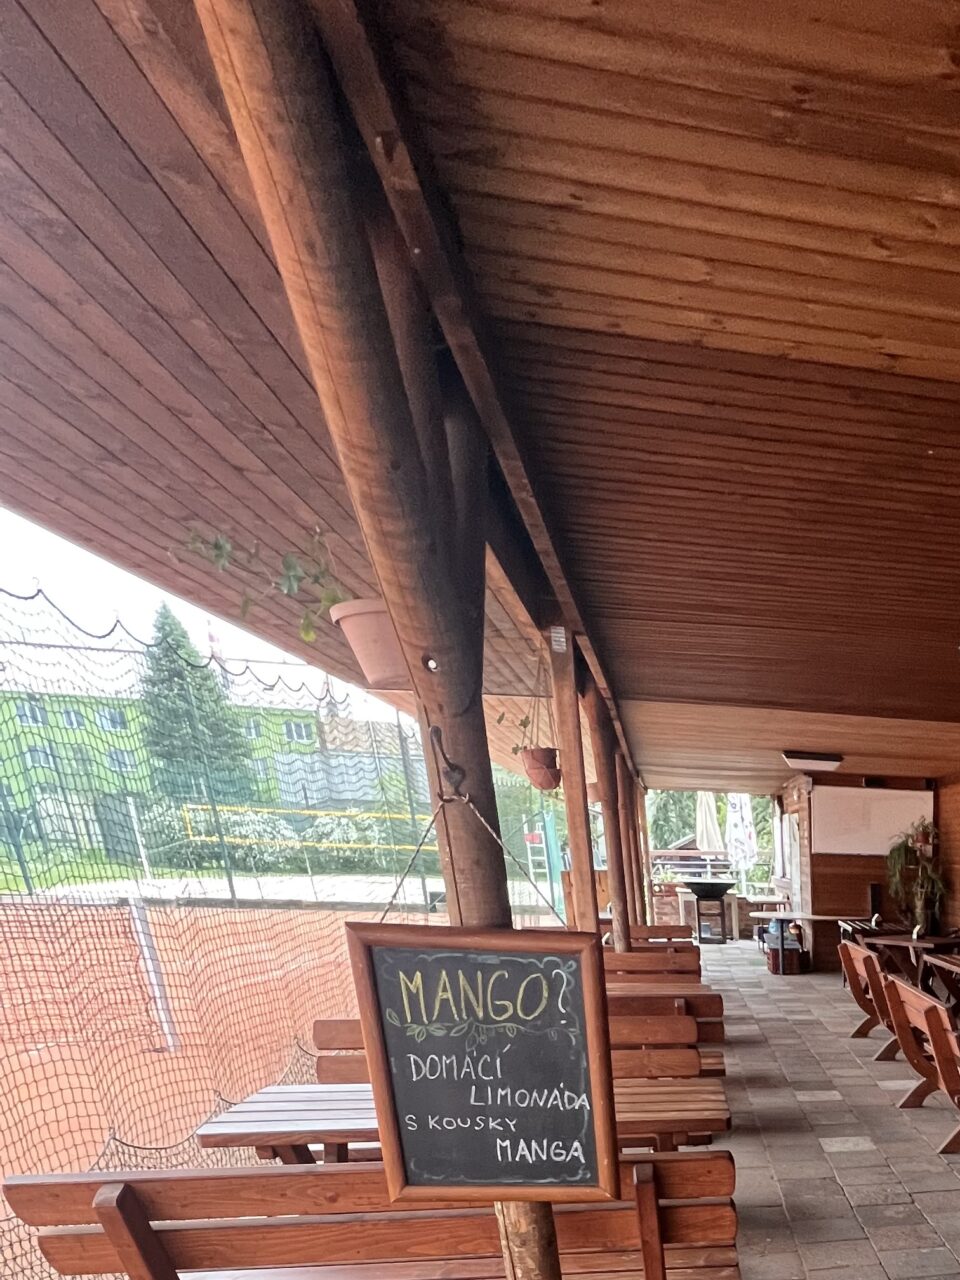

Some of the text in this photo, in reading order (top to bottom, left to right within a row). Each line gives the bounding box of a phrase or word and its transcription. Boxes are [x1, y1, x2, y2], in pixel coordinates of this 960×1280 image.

[399, 969, 568, 1024] MANGO?
[407, 1043, 511, 1081] DOMÁCÍ
[470, 1082, 590, 1111] LIMONÁDA
[405, 1114, 518, 1133] S KOUSKY
[496, 1138, 586, 1164] MANGA
